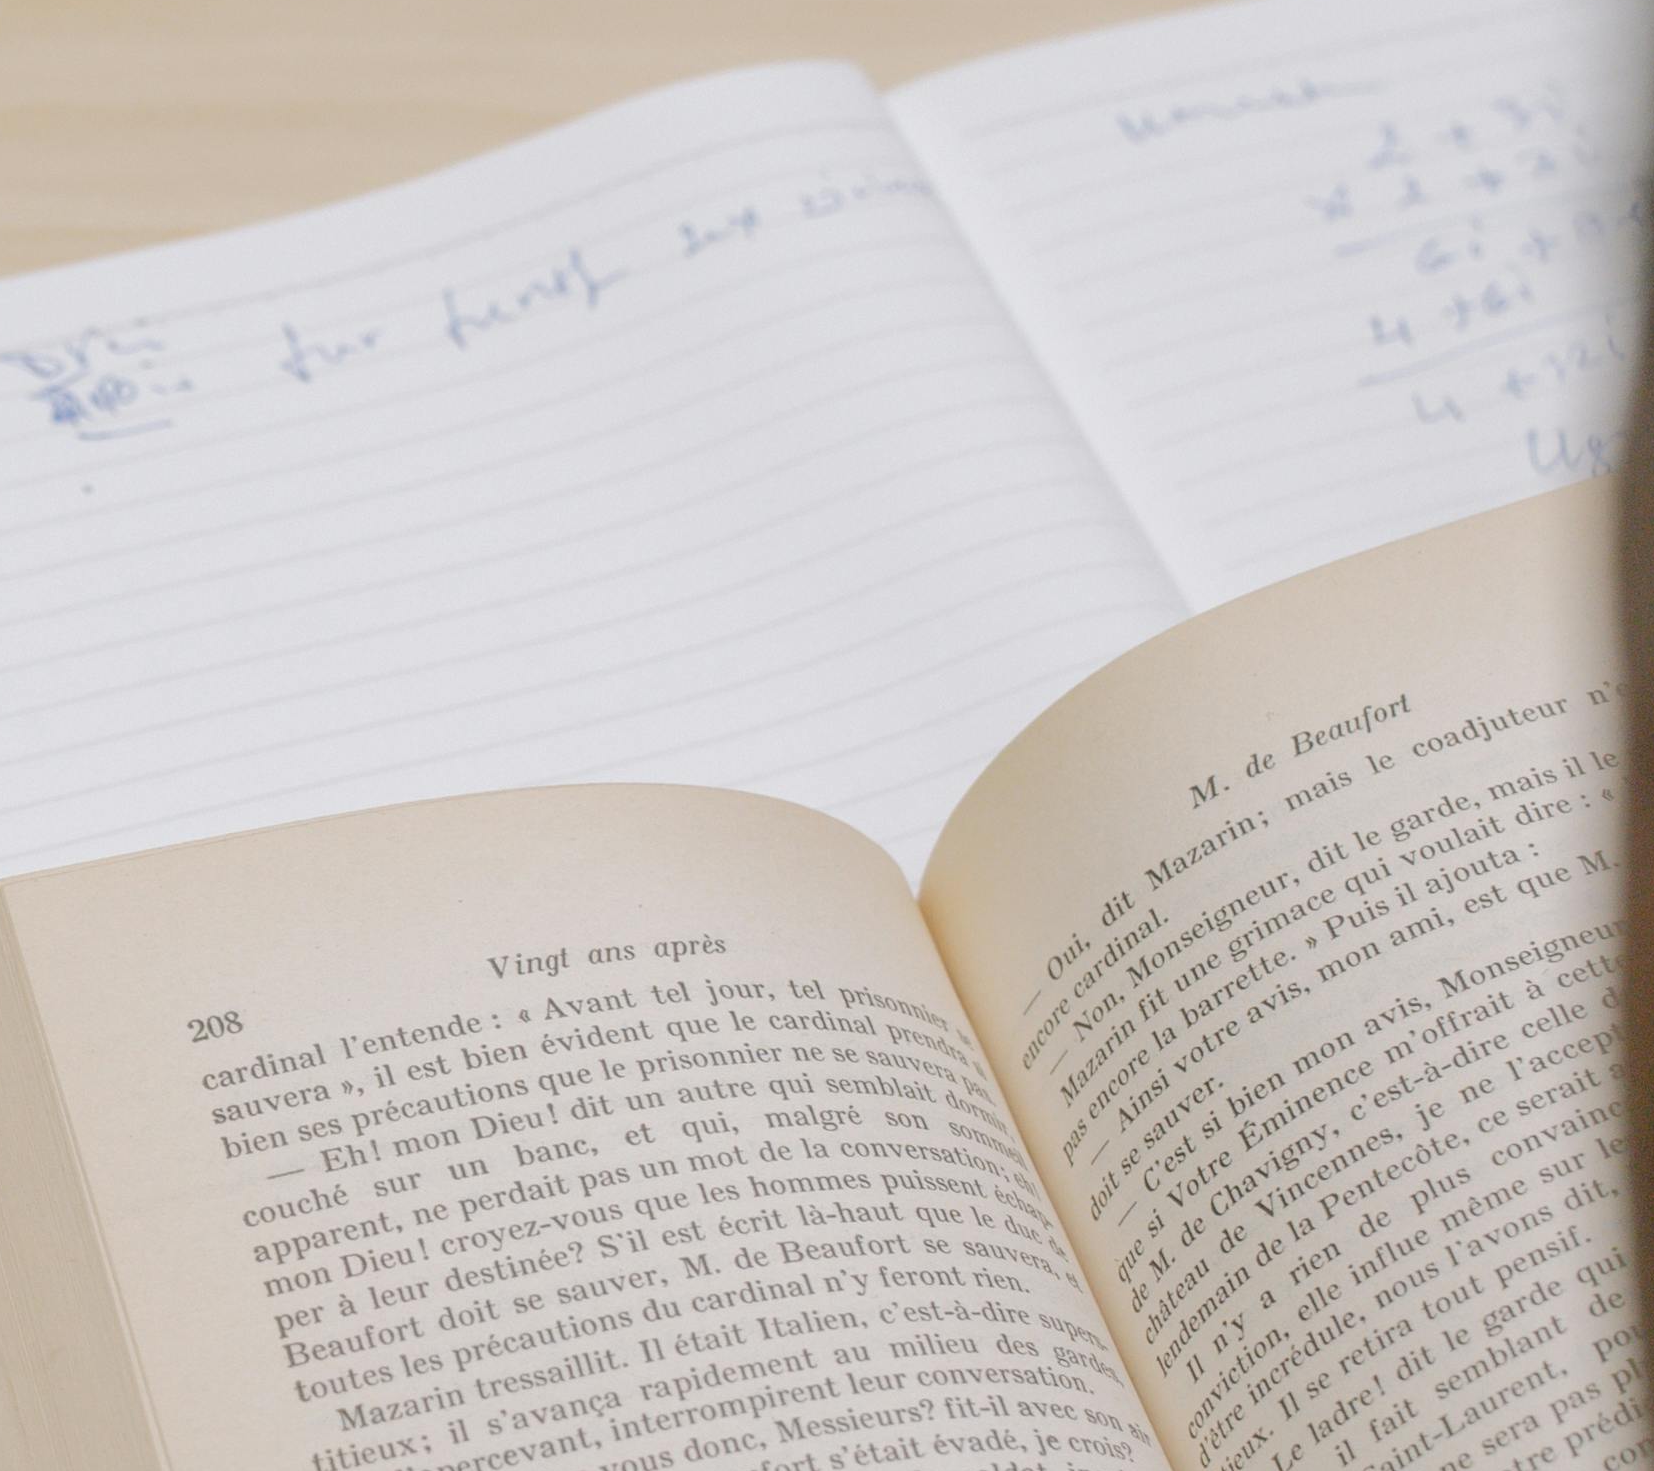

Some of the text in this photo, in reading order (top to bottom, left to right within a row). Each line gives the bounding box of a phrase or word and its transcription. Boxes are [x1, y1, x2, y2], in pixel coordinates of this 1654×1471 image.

[1188, 693, 1412, 810] M. de Beaufort
[486, 933, 727, 980] Vingt ans après
[1022, 907, 1170, 1071] encore cardinal.
[1058, 799, 1573, 1109] Mazarin fit une grimace qui voulait dire
[186, 1010, 245, 1044] 208
[219, 1130, 289, 1160] bien
[297, 1118, 343, 1142] ses
[350, 1079, 530, 1137] précautions
[537, 1067, 593, 1097] que
[598, 1058, 626, 1081] le
[635, 1042, 783, 1082] prisonnier
[791, 1046, 825, 1062] ne
[831, 1047, 860, 1064] se
[865, 1050, 958, 1084] sauvera
[242, 1183, 349, 1228] couché
[373, 1172, 422, 1198] sur
[447, 1158, 490, 1181] un
[512, 1139, 599, 1167] banc,
[624, 1122, 656, 1147] et
[681, 1110, 740, 1144] qui,
[763, 1104, 863, 1132] malgré
[884, 1111, 930, 1131] son
[1089, 1076, 1225, 1222] doit se sauver.
[1116, 1237, 1146, 1285] que
[1146, 1207, 1166, 1240] si
[1165, 1150, 1233, 1208] Votre
[1237, 1060, 1374, 1153] Éminence
[1383, 991, 1515, 1065] m'offrait
[1525, 979, 1546, 1001] à
[252, 1137, 1010, 1266] apparent, ne perdait pas un mot de la conversation;
[262, 1266, 333, 1298] mon
[339, 1237, 430, 1279] Dieu!
[440, 1203, 624, 1256] croyez-vous
[634, 1192, 690, 1221] que
[696, 1182, 741, 1205] les
[746, 1173, 872, 1198] hommes
[879, 1169, 988, 1199] puissent
[1145, 1078, 1495, 1346] château de Vincennes, je ne
[293, 1265, 1031, 1403] toutes les précautions du cardinal n'y feront rien.
[1188, 1137, 1628, 1440] conviction, elle influe même sur le
[1199, 1179, 1619, 1469] d'être incrédule, nous l'avons dit,
[1277, 1390, 1301, 1422] Il
[1305, 1372, 1331, 1400] se
[1338, 1318, 1414, 1376] retira
[1421, 1275, 1485, 1321] tout
[1493, 1224, 1592, 1291] pensif.
[335, 1299, 1030, 1432] Mazarin tressaillit. Il était Italien, c'est-à-dire
[609, 1376, 841, 1442] interrompirent
[845, 1372, 907, 1395] leur
[916, 1366, 1095, 1395] conversation.
[828, 1437, 925, 1471] s'était
[932, 1428, 1028, 1456] évadé,
[1033, 1428, 1061, 1457] je
[1067, 1436, 1134, 1463] crois?
